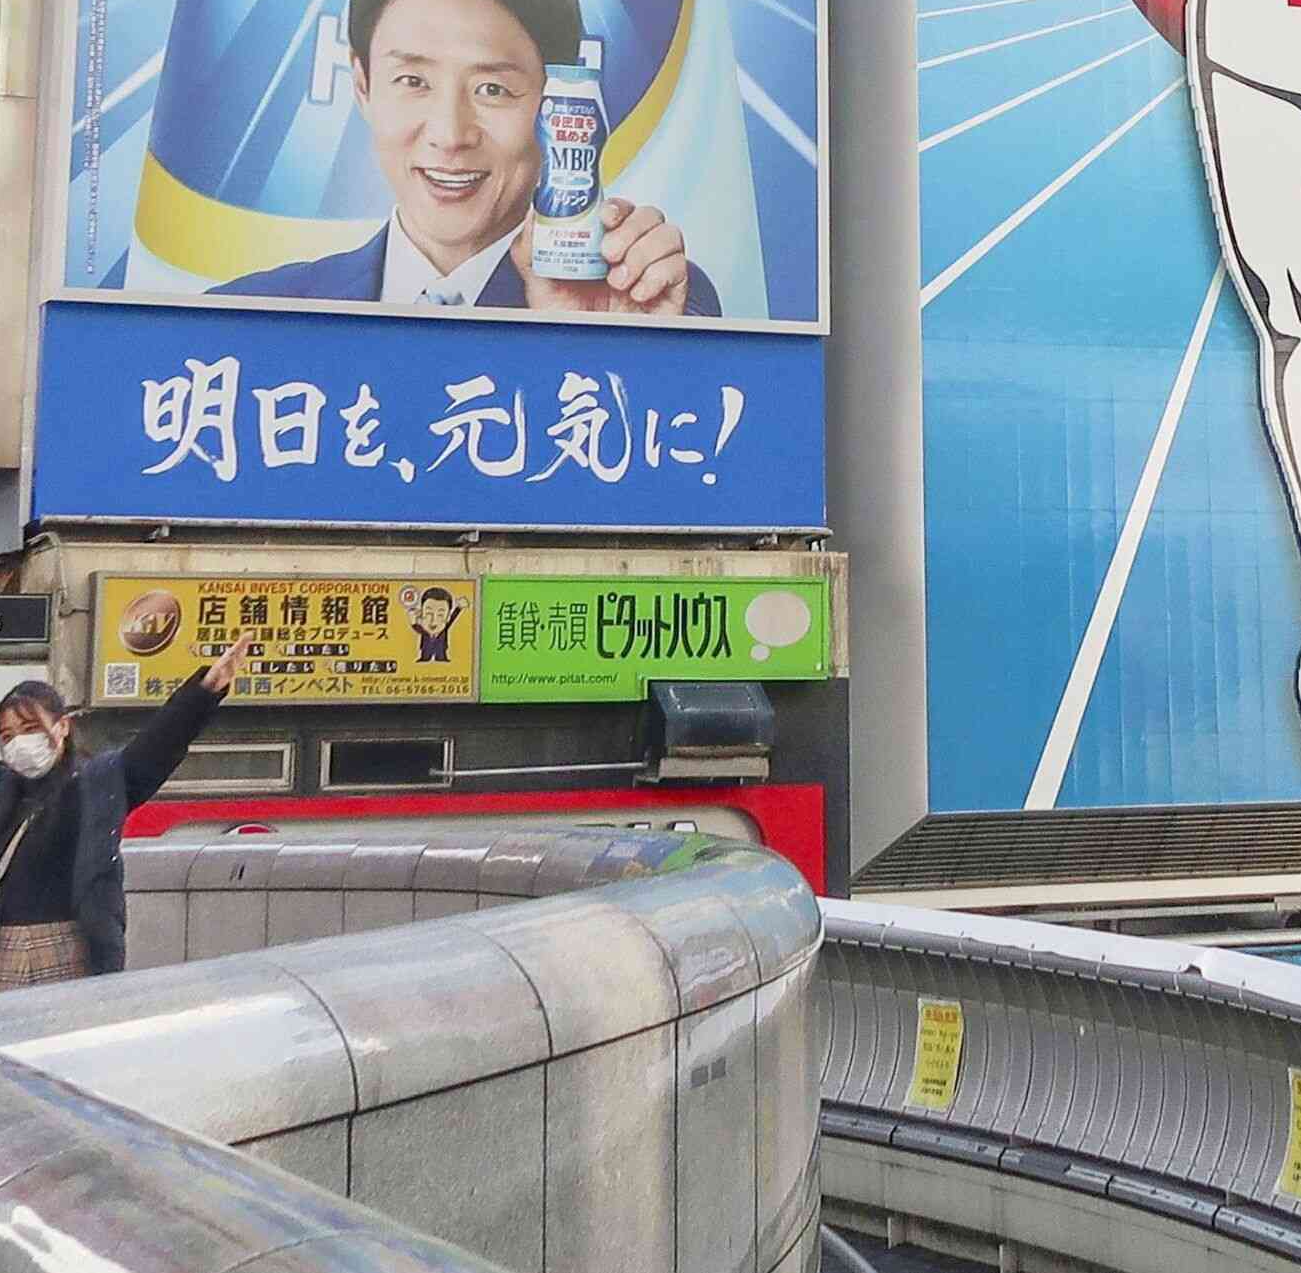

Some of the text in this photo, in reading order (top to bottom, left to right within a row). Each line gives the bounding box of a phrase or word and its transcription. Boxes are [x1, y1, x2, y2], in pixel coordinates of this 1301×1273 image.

[550, 146, 597, 173] MBP
[196, 581, 390, 596] KANSAI INVEST CORPORATION
[198, 594, 391, 628] 店舗情報館
[596, 591, 733, 660] ピタットハウス
[491, 671, 618, 686] http://www.pitat.com/
[360, 685, 382, 696] TEL
